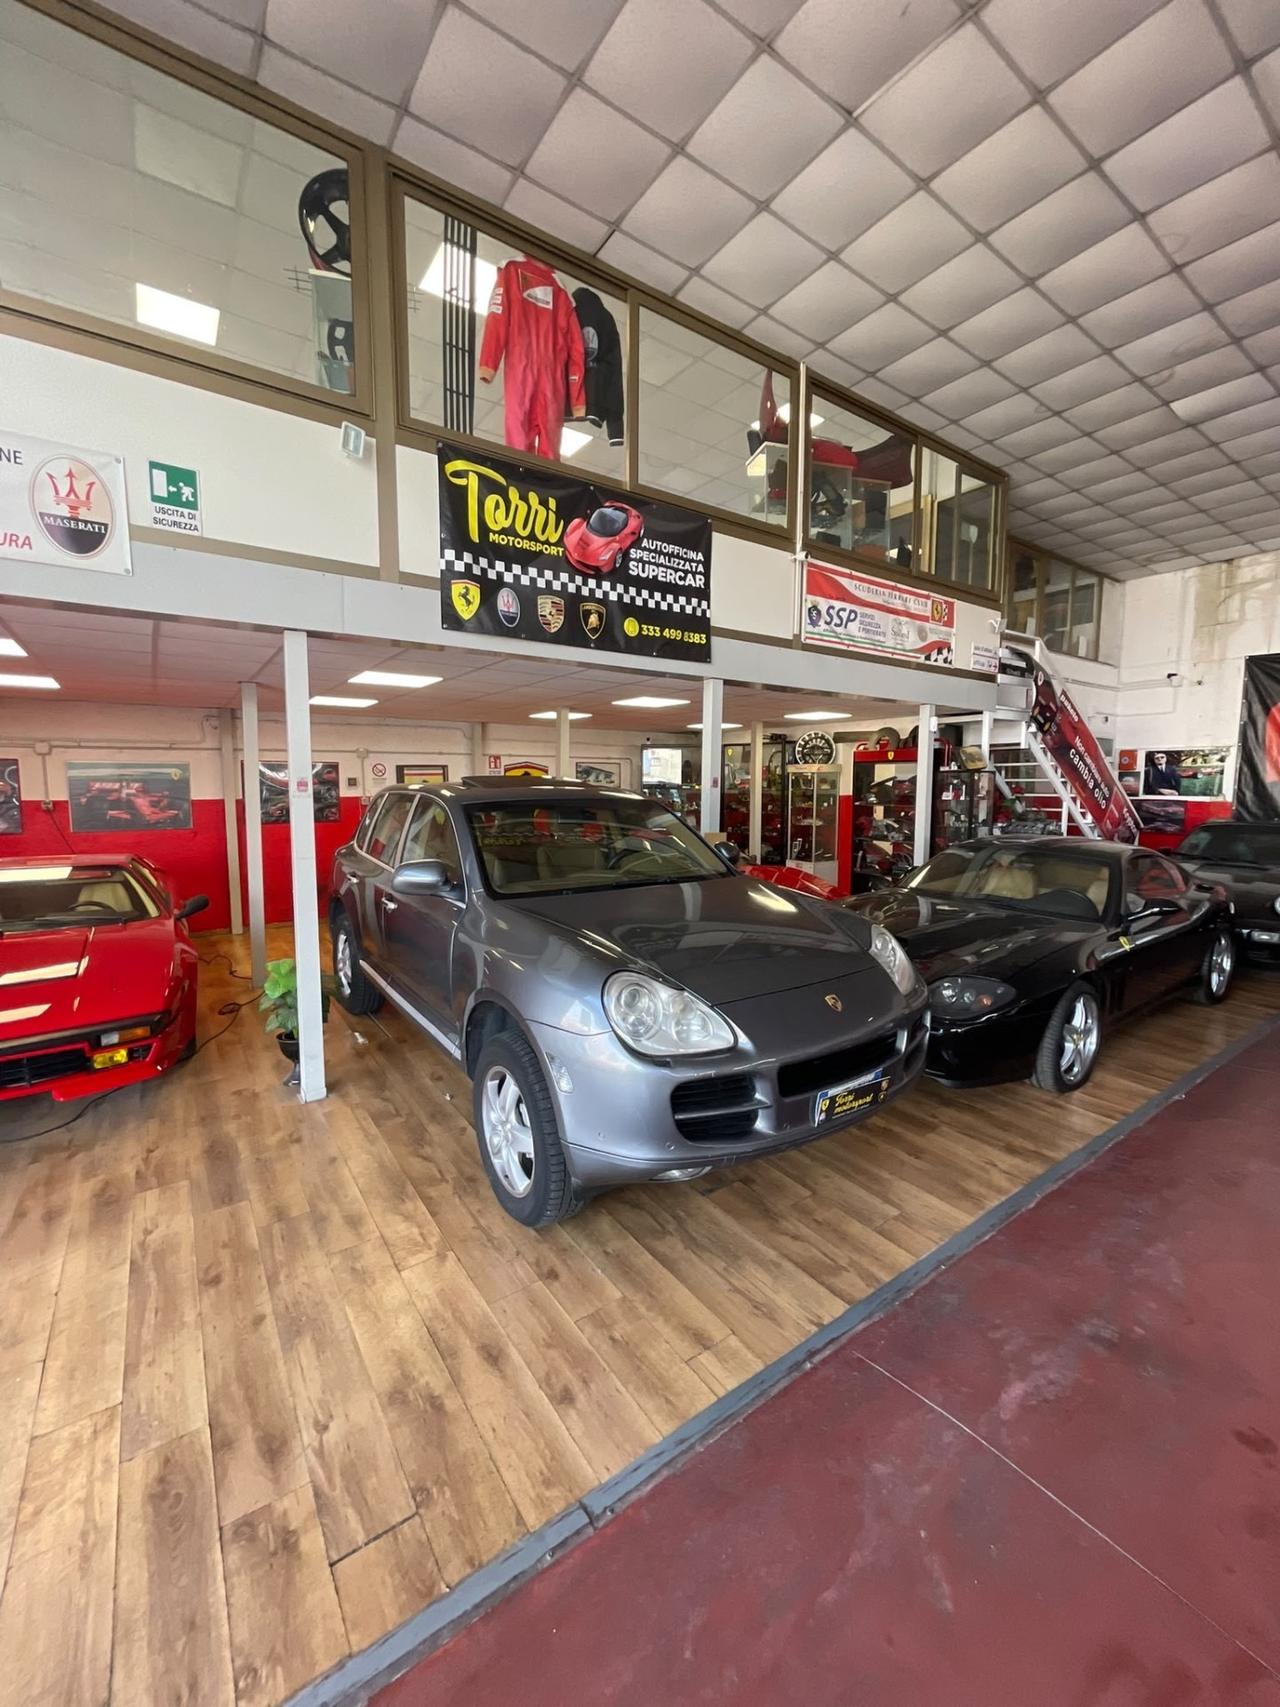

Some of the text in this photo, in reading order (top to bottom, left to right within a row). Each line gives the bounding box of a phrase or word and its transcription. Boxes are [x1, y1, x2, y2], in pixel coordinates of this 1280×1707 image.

[154, 505, 197, 520] USCITA DI
[444, 459, 564, 543] Torri
[43, 515, 106, 534] MASERATI
[152, 516, 199, 532] SICUREZZA
[489, 532, 564, 557] MOTORSPORT
[641, 538, 705, 562] AUTOFFICINA
[629, 548, 705, 573] SPECIALIZZATA
[628, 560, 705, 589] SUPERCAR
[854, 583, 886, 597] SCUDERIA
[824, 604, 858, 629] SSP
[641, 624, 707, 644] 333 499 8383
[1074, 735, 1086, 753] Non
[1070, 748, 1107, 809] cambia olio
